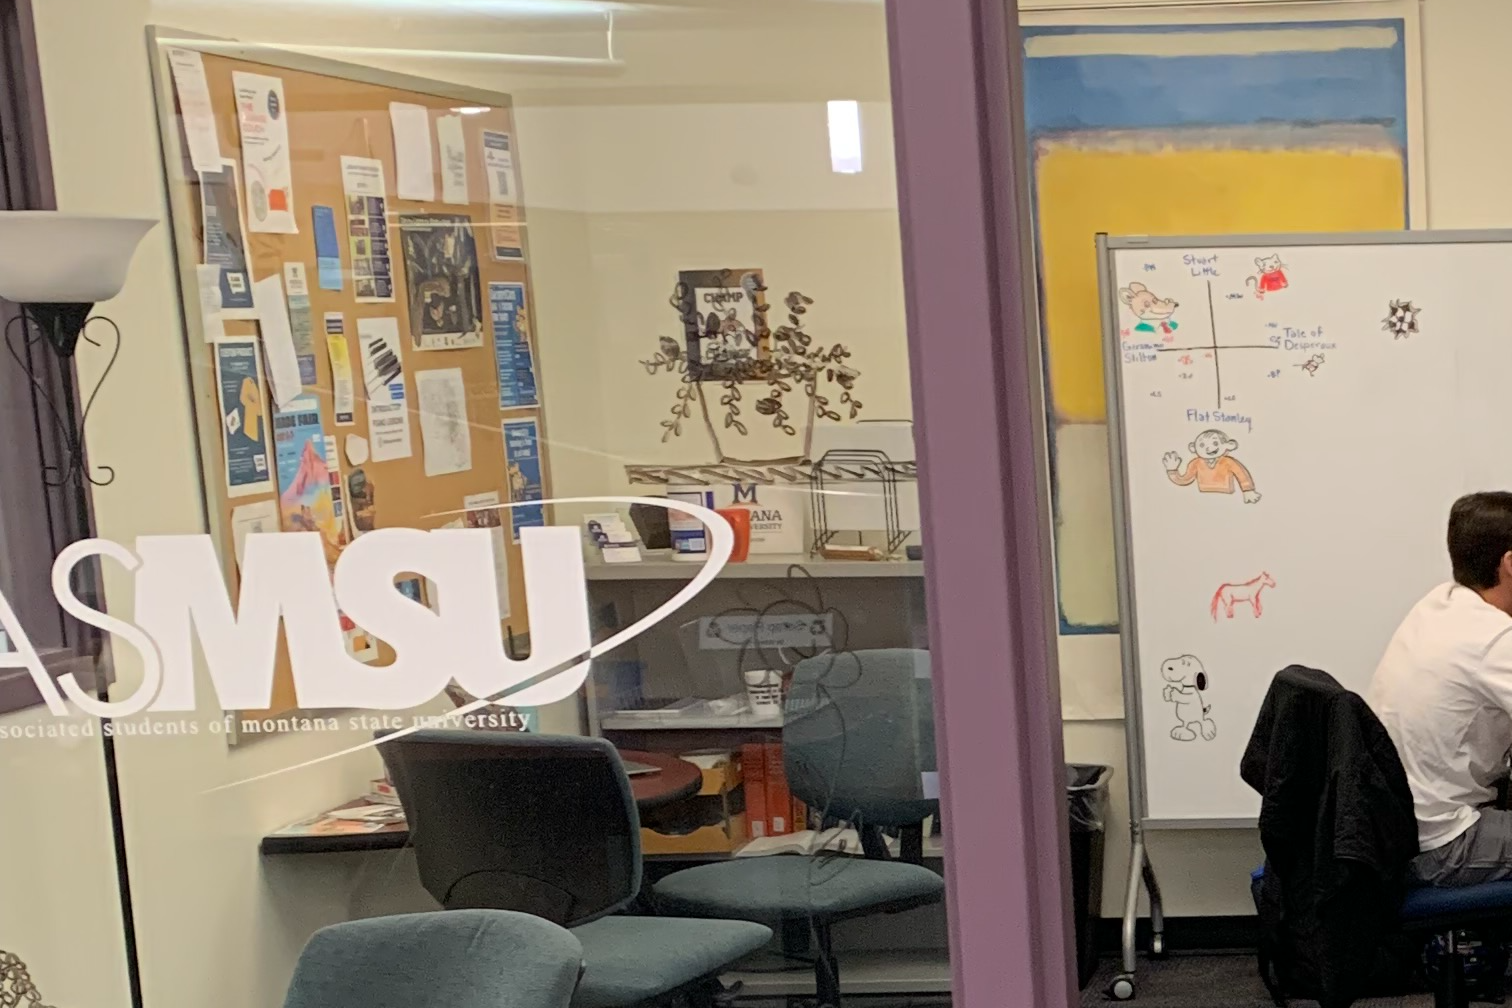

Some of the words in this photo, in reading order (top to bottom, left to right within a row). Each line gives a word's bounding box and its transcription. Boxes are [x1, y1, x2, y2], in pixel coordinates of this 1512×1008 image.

[1183, 254, 1219, 265] Stuart
[1283, 327, 1307, 338] Tale
[1310, 325, 1323, 338] of
[1186, 408, 1210, 422] Flat
[1213, 410, 1252, 433] Stanley
[103, 719, 198, 737] students
[208, 715, 234, 735] of
[241, 717, 340, 734] montana
[350, 713, 403, 731] state
[414, 709, 531, 732] university
